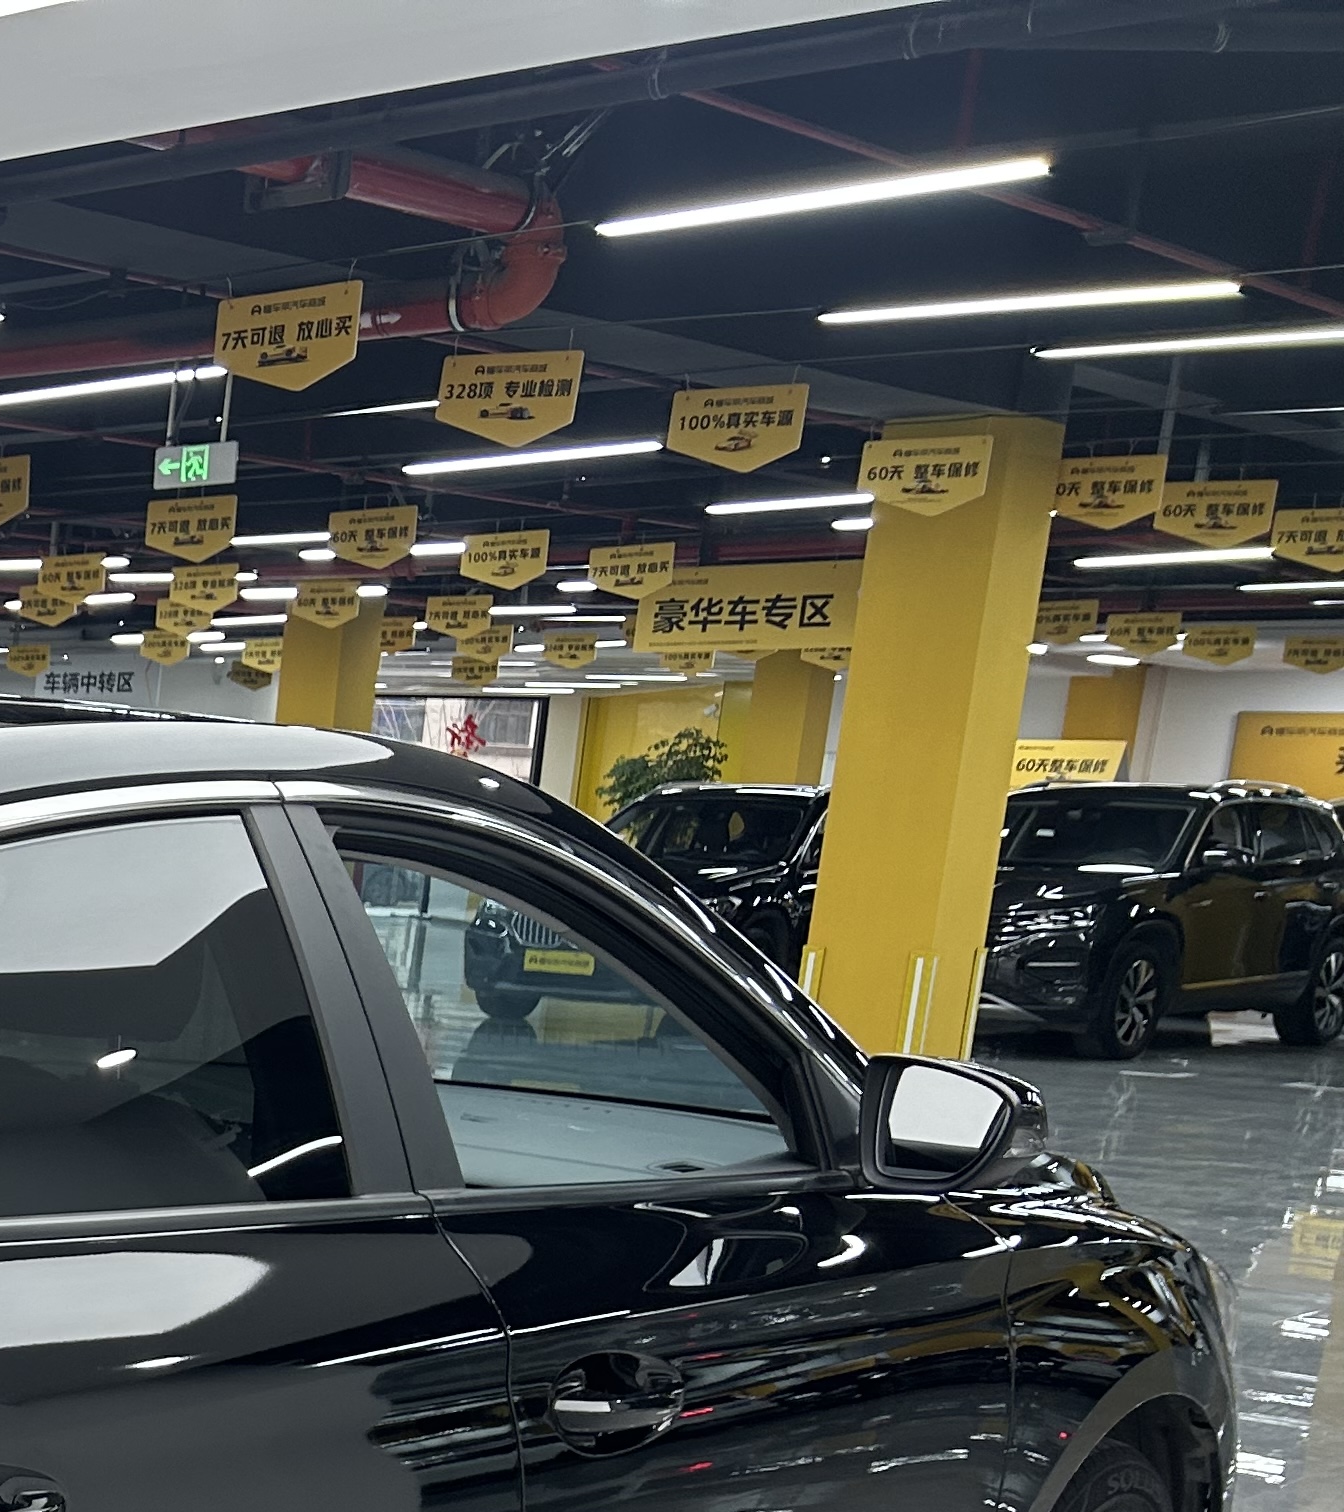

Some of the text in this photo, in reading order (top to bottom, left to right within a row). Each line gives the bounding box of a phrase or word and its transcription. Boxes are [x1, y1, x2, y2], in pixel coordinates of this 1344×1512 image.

[221, 314, 353, 352] 7天可退 放心买
[444, 377, 574, 400] 328项 专业检测
[679, 409, 795, 431] 100%真实车源
[867, 460, 981, 482] 60天 整车保修
[1055, 481, 1081, 497] 0天
[1162, 503, 1197, 518] 60天
[652, 593, 834, 633] 豪华车专区
[43, 670, 135, 695] 车辆中转区
